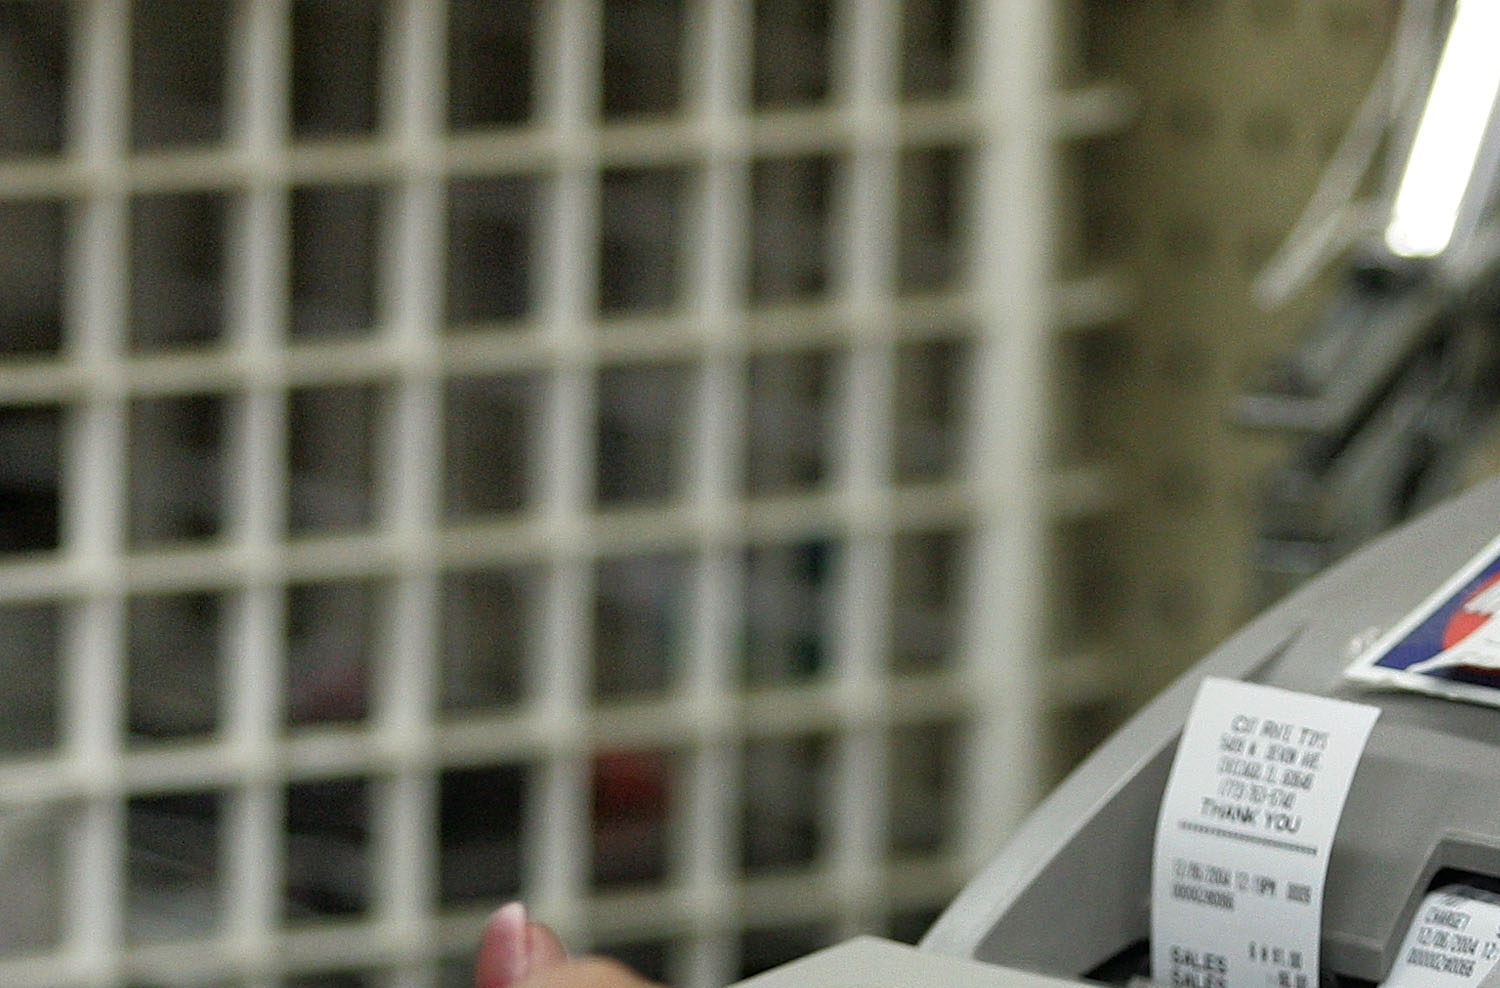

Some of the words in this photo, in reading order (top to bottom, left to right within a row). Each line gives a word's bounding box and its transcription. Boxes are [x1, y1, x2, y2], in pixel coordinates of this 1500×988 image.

[1201, 797, 1258, 826] THANK
[1264, 811, 1302, 834] YOU
[1171, 945, 1228, 973] SALES
